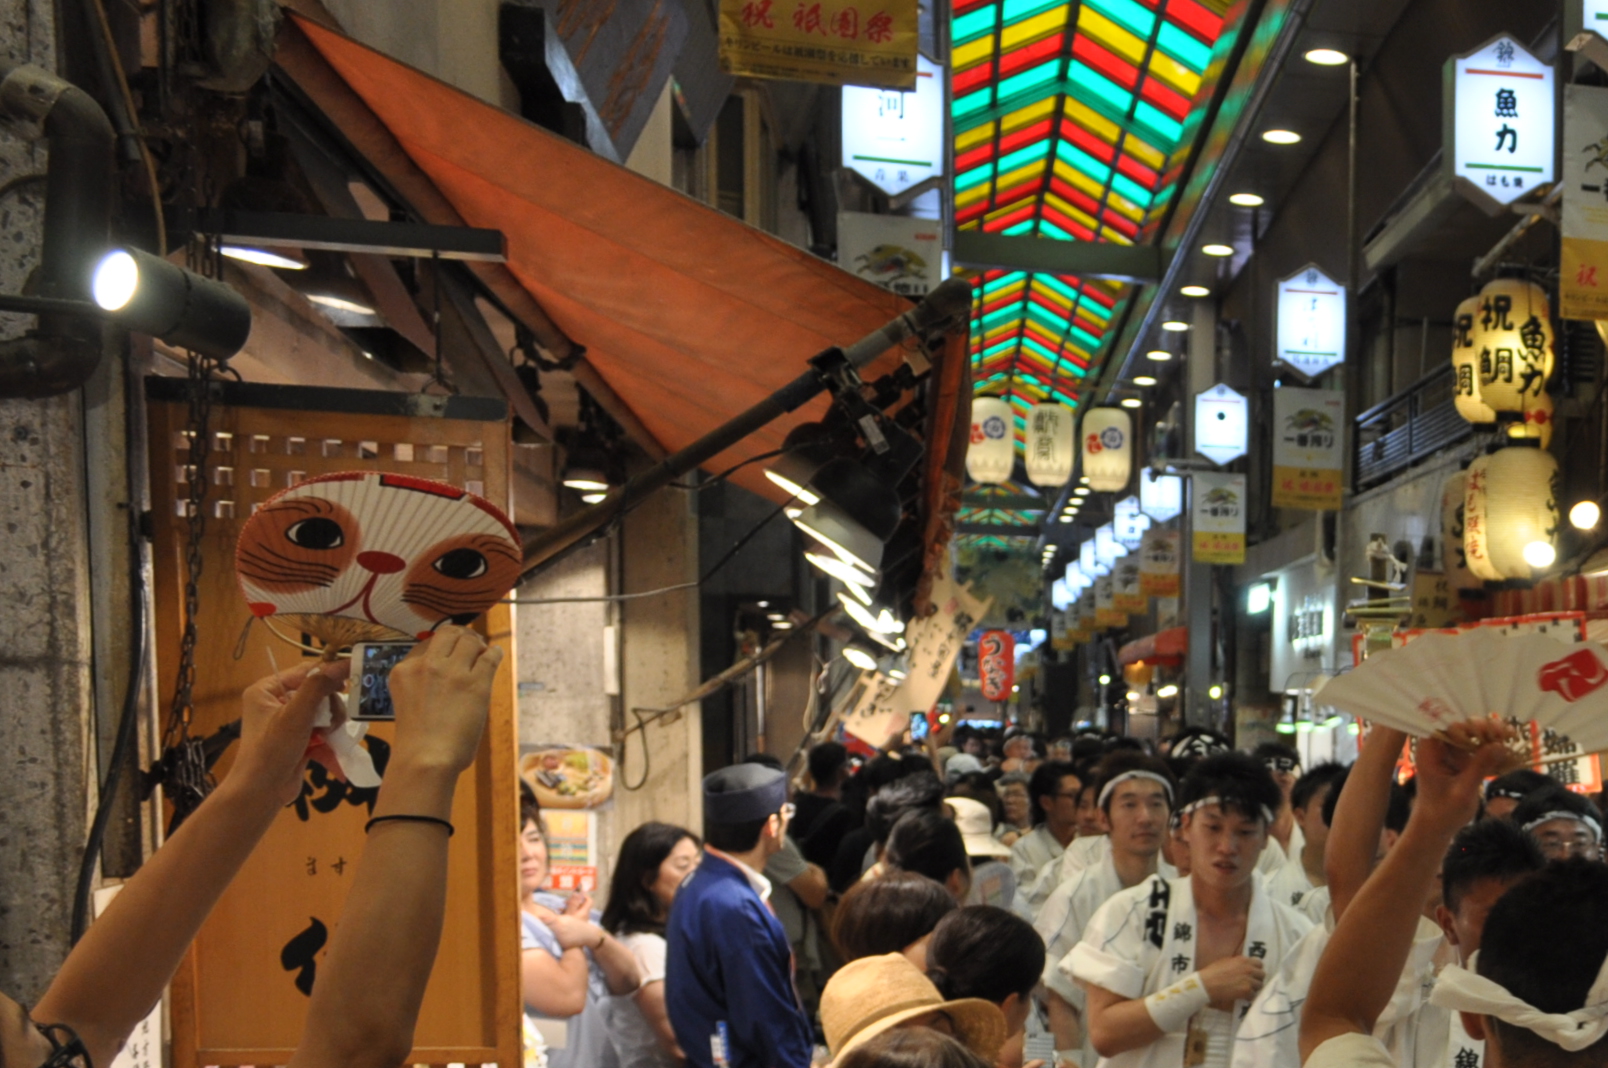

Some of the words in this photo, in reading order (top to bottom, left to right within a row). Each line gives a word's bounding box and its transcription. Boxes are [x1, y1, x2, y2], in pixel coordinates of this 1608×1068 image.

[793, 2, 894, 44] 祇園祭
[1494, 88, 1519, 154] 魚力
[1577, 265, 1598, 288] 祝
[1480, 294, 1514, 384] 祝鯛
[1517, 314, 1545, 397] 魚力
